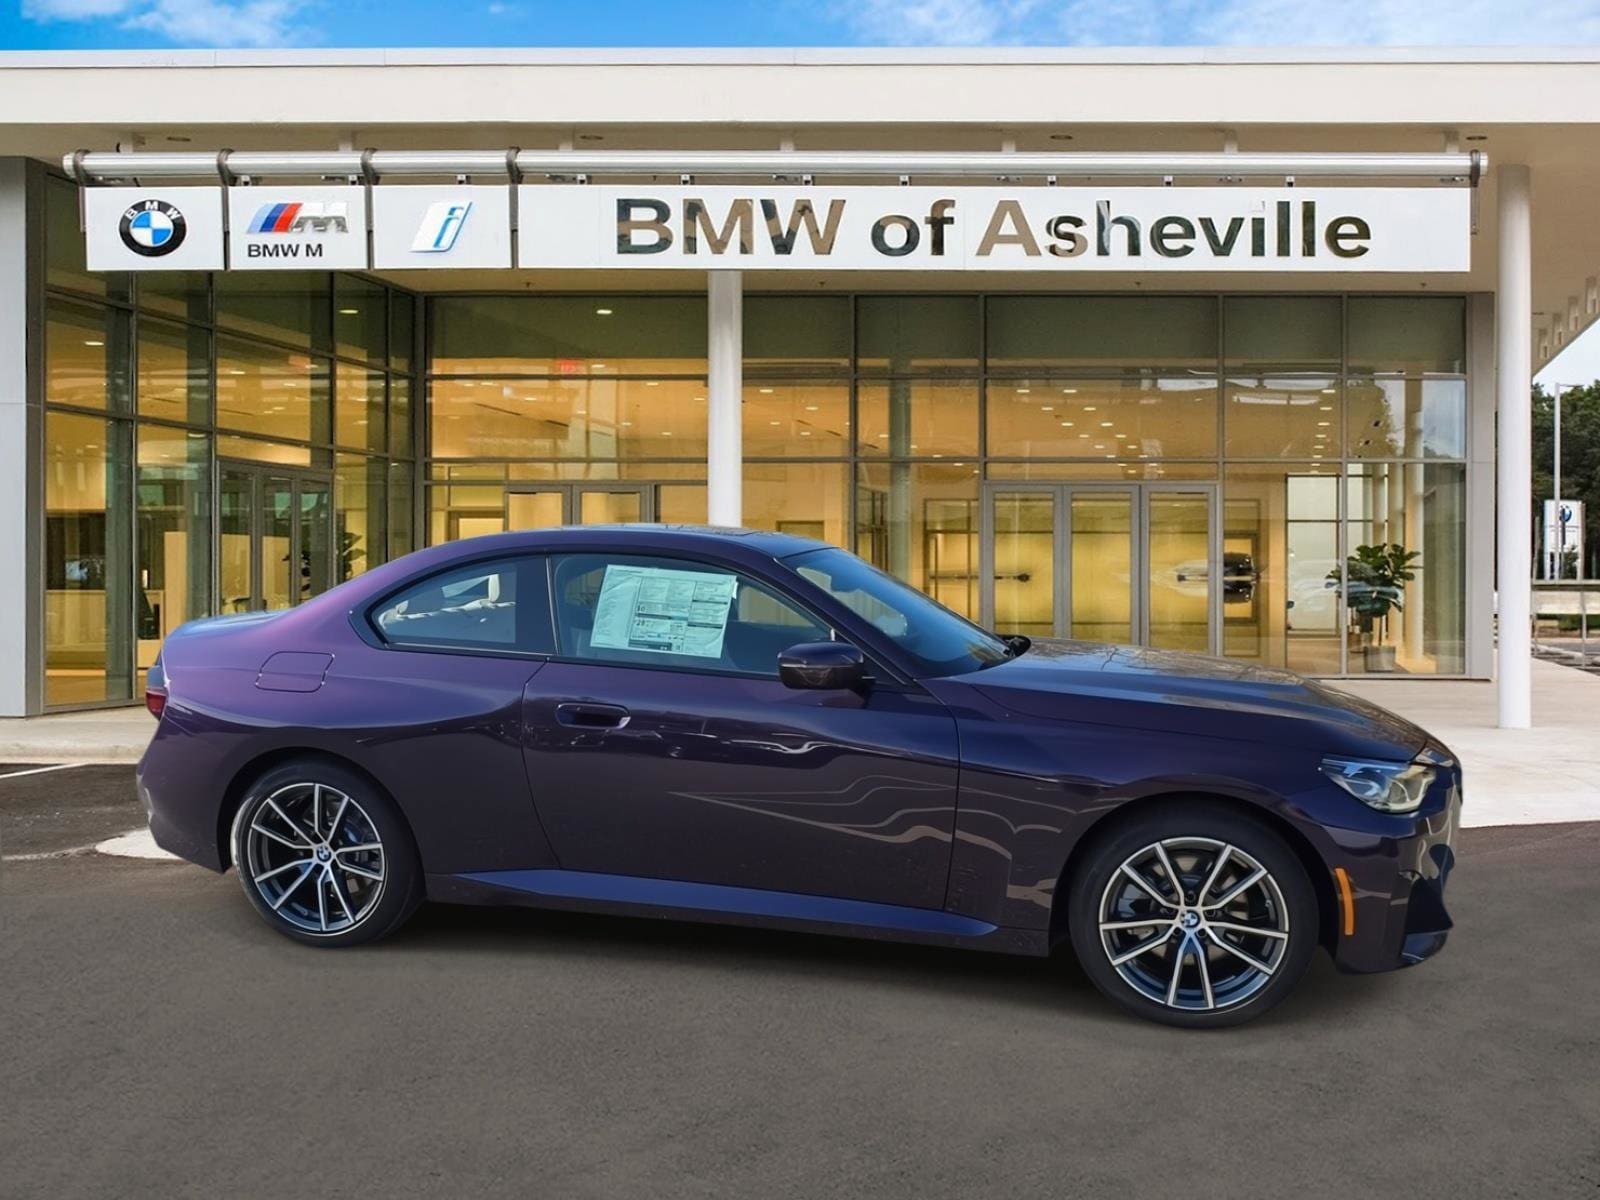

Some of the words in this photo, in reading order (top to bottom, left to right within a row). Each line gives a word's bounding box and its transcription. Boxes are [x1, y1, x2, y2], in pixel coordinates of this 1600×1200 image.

[125, 200, 181, 220] BMW
[616, 198, 846, 256] BMW
[870, 198, 956, 257] of
[975, 199, 1372, 258] Asheville
[247, 243, 300, 257] BMW
[305, 243, 323, 257] M
